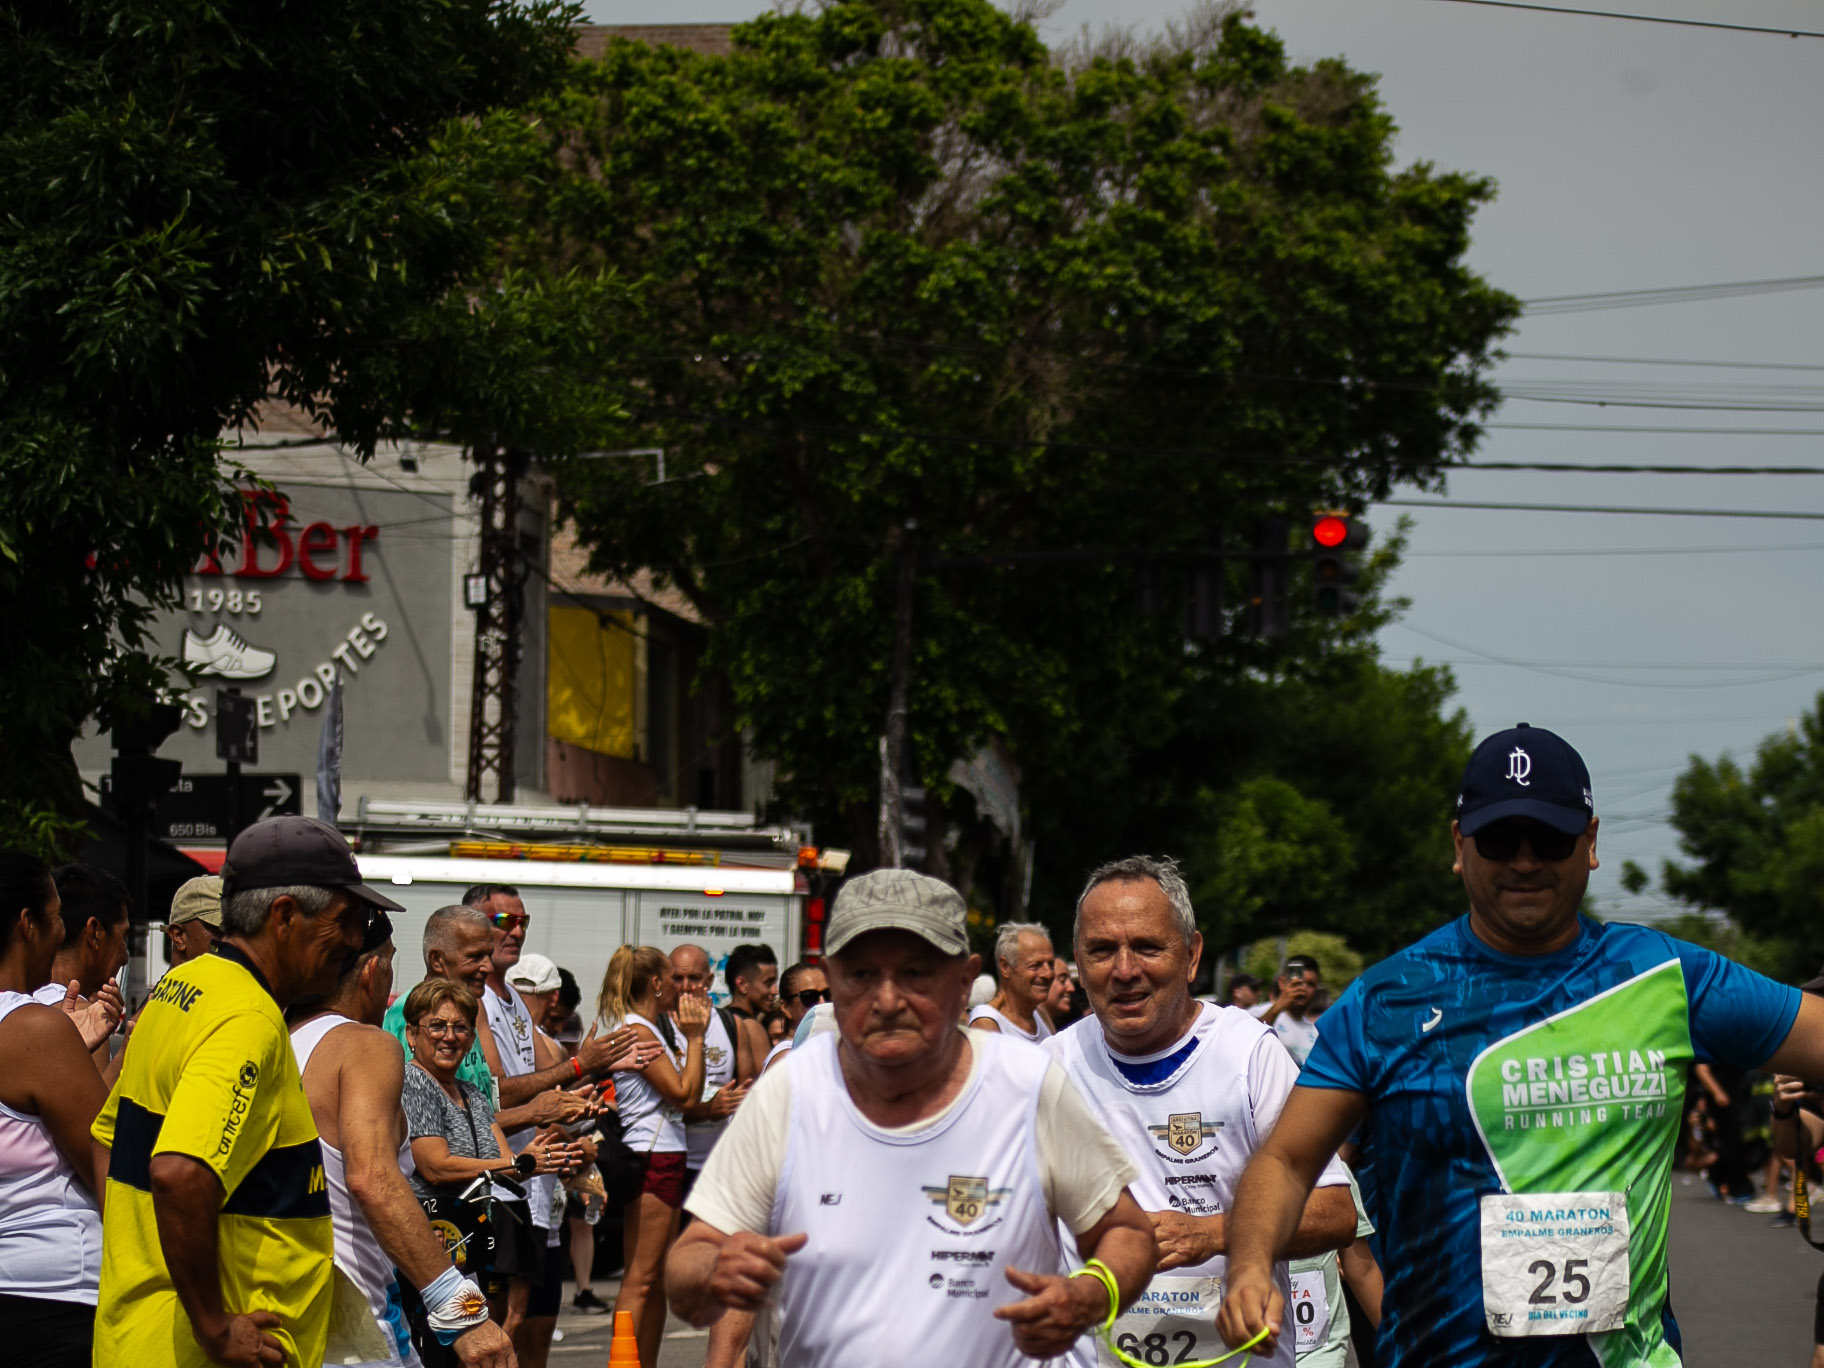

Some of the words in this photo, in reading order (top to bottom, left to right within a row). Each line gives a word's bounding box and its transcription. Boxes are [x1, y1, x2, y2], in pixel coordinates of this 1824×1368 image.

[190, 587, 263, 614] 1985
[256, 611, 389, 728] EPORTES
[169, 823, 193, 836] 650
[195, 823, 217, 836] Bis
[1501, 1050, 1665, 1083] CRISTIAN
[1503, 1073, 1667, 1107] MENEGUZZI
[1505, 1108, 1608, 1130] RUNNING
[1623, 1103, 1666, 1120] TEAM
[1175, 1135, 1195, 1147] 40
[1155, 1149, 1184, 1164] EMPALME
[1185, 1146, 1219, 1164] GRANEROS
[1182, 1197, 1206, 1206] Banco
[1184, 1203, 1221, 1214] Municipal
[955, 1203, 978, 1217] 40
[1505, 1210, 1525, 1223] 40
[1530, 1208, 1610, 1223] MARATON
[1501, 1227, 1555, 1239] EMPALME
[1557, 1225, 1614, 1238] GRANEROS
[948, 1278, 976, 1288] Banco
[1527, 1259, 1591, 1305] 25
[1141, 1291, 1200, 1302] ARATON
[1126, 1307, 1151, 1315] ALME
[1528, 1311, 1542, 1321] DIA
[1543, 1311, 1557, 1320] DEL
[1559, 1309, 1589, 1319] VECINO
